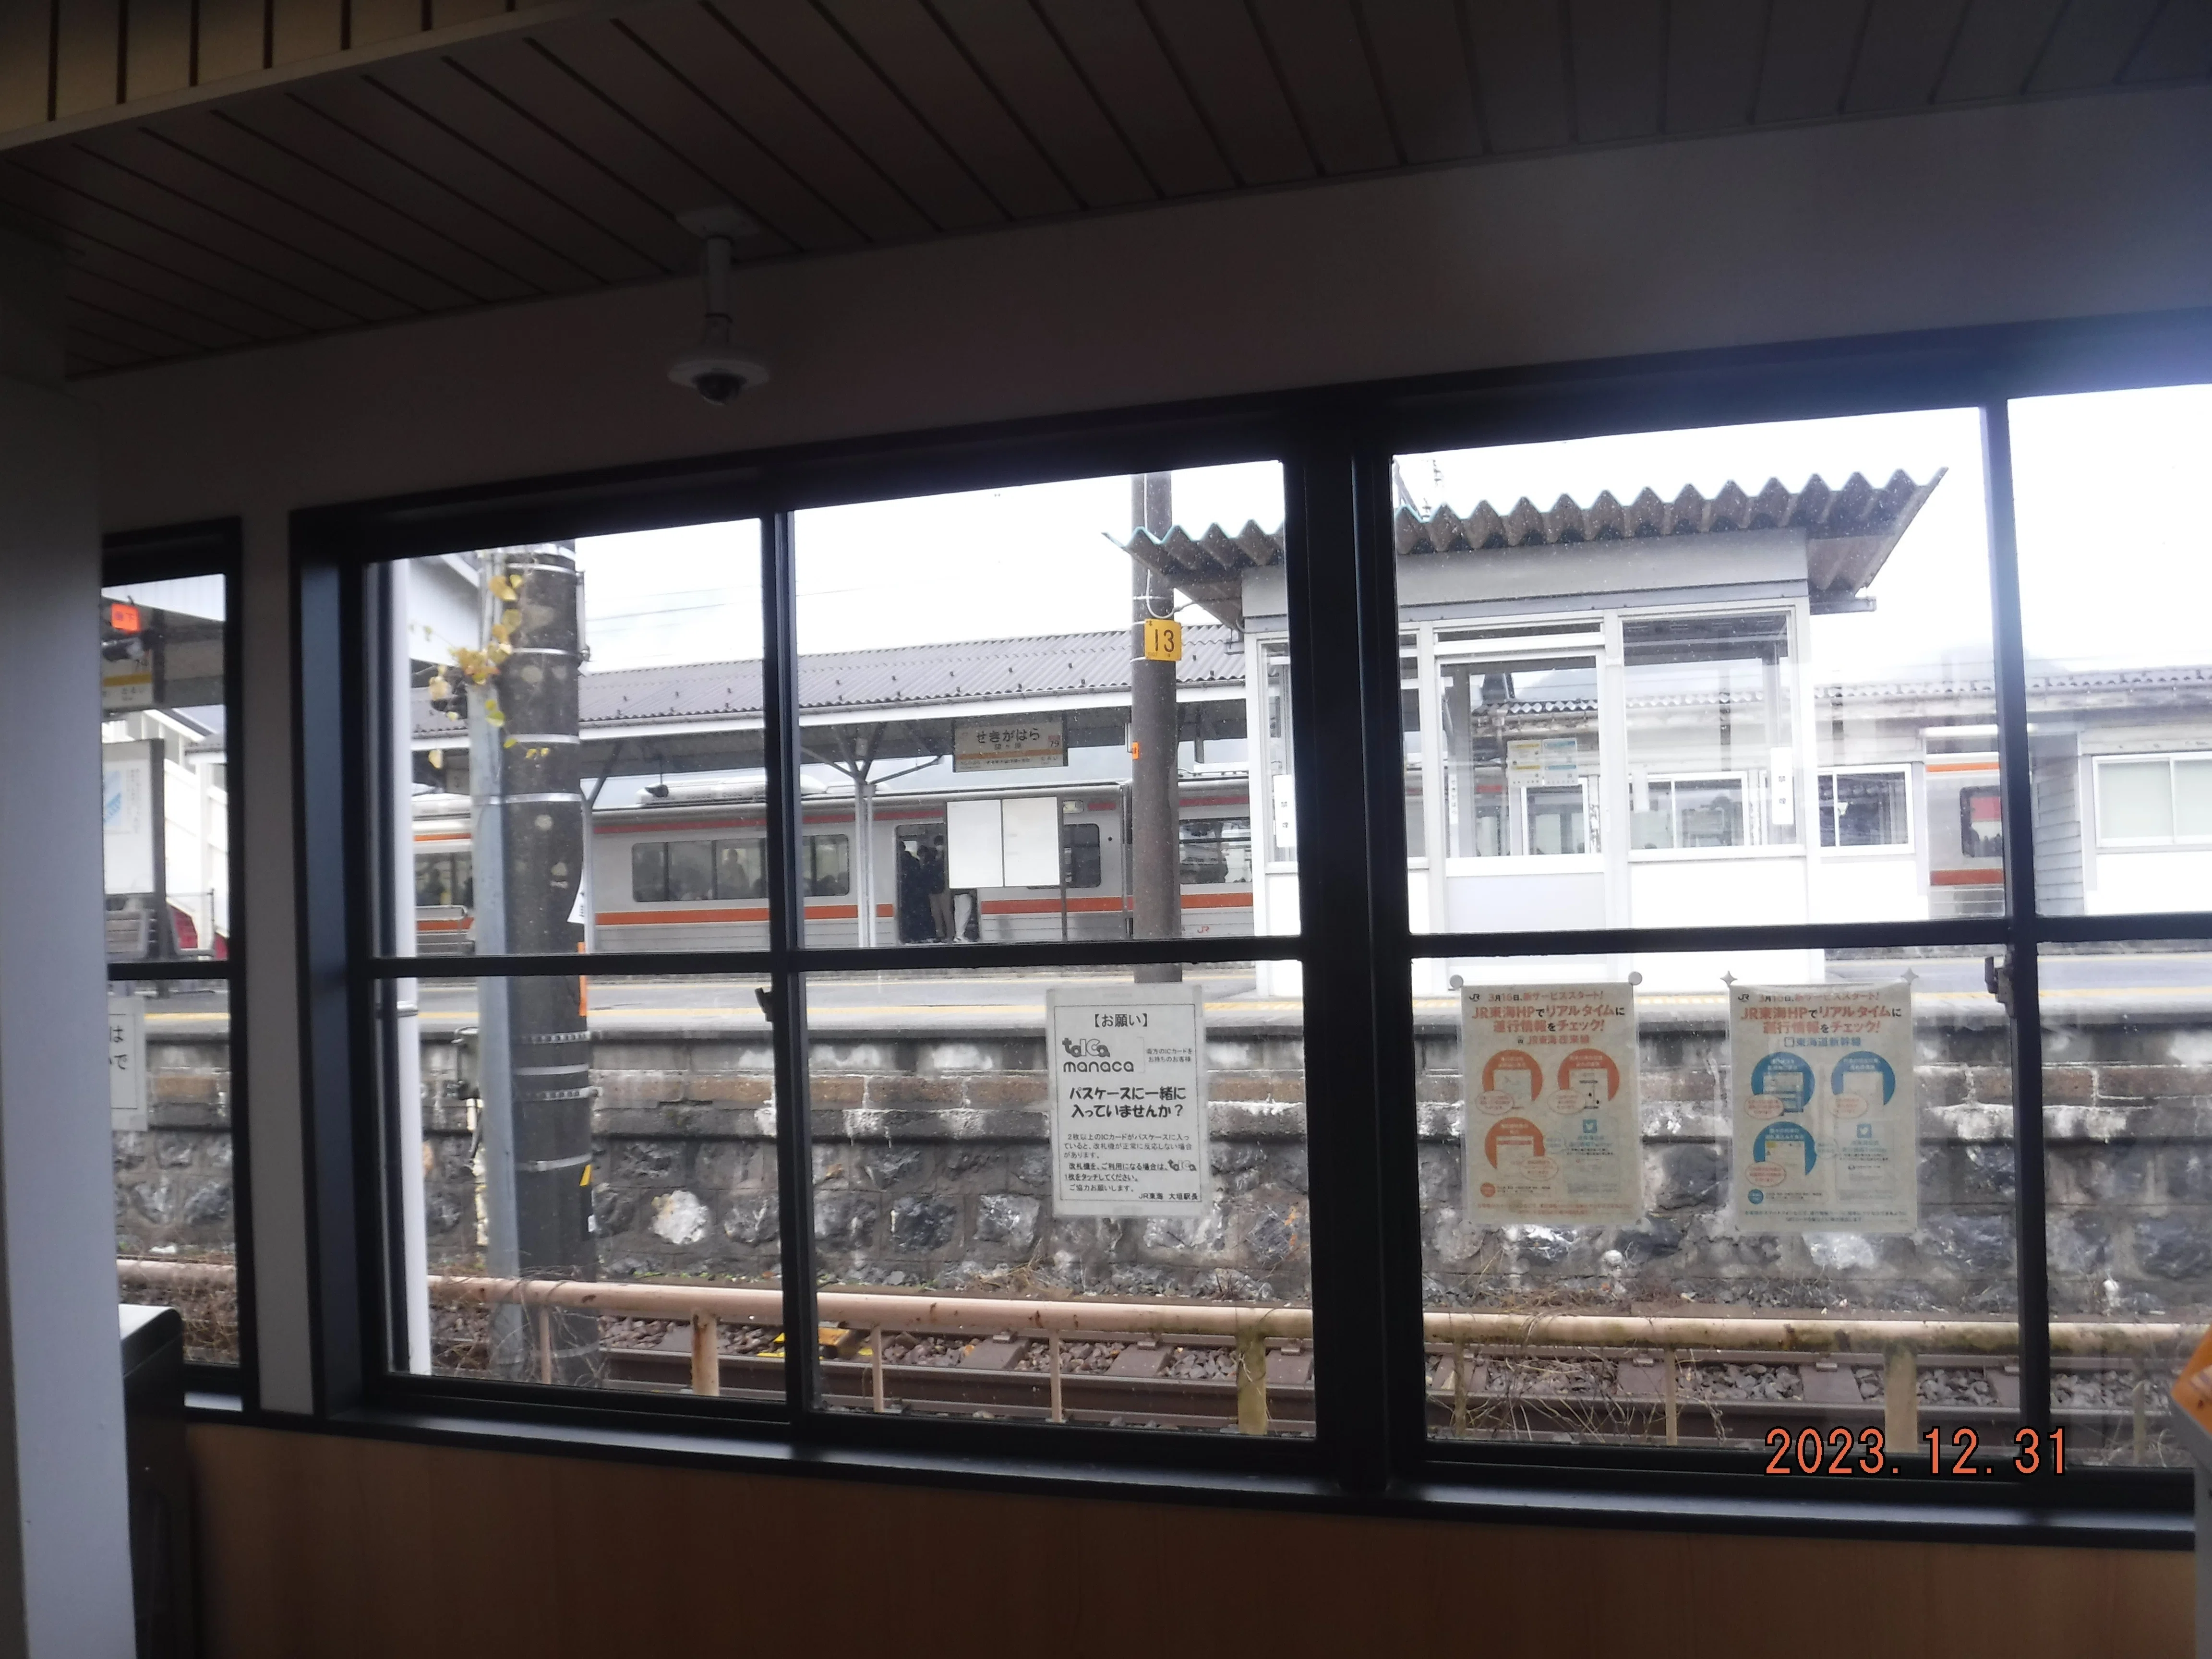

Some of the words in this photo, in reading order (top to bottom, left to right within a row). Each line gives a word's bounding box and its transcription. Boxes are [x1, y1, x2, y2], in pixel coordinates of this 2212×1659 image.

[1155, 629, 1174, 652] 13
[976, 728, 1040, 744] せきがはら
[1094, 1013, 1148, 1027] 【お願い】
[1063, 1061, 1134, 1072] manaca
[1069, 1086, 1187, 1101] パスケースに一緒に
